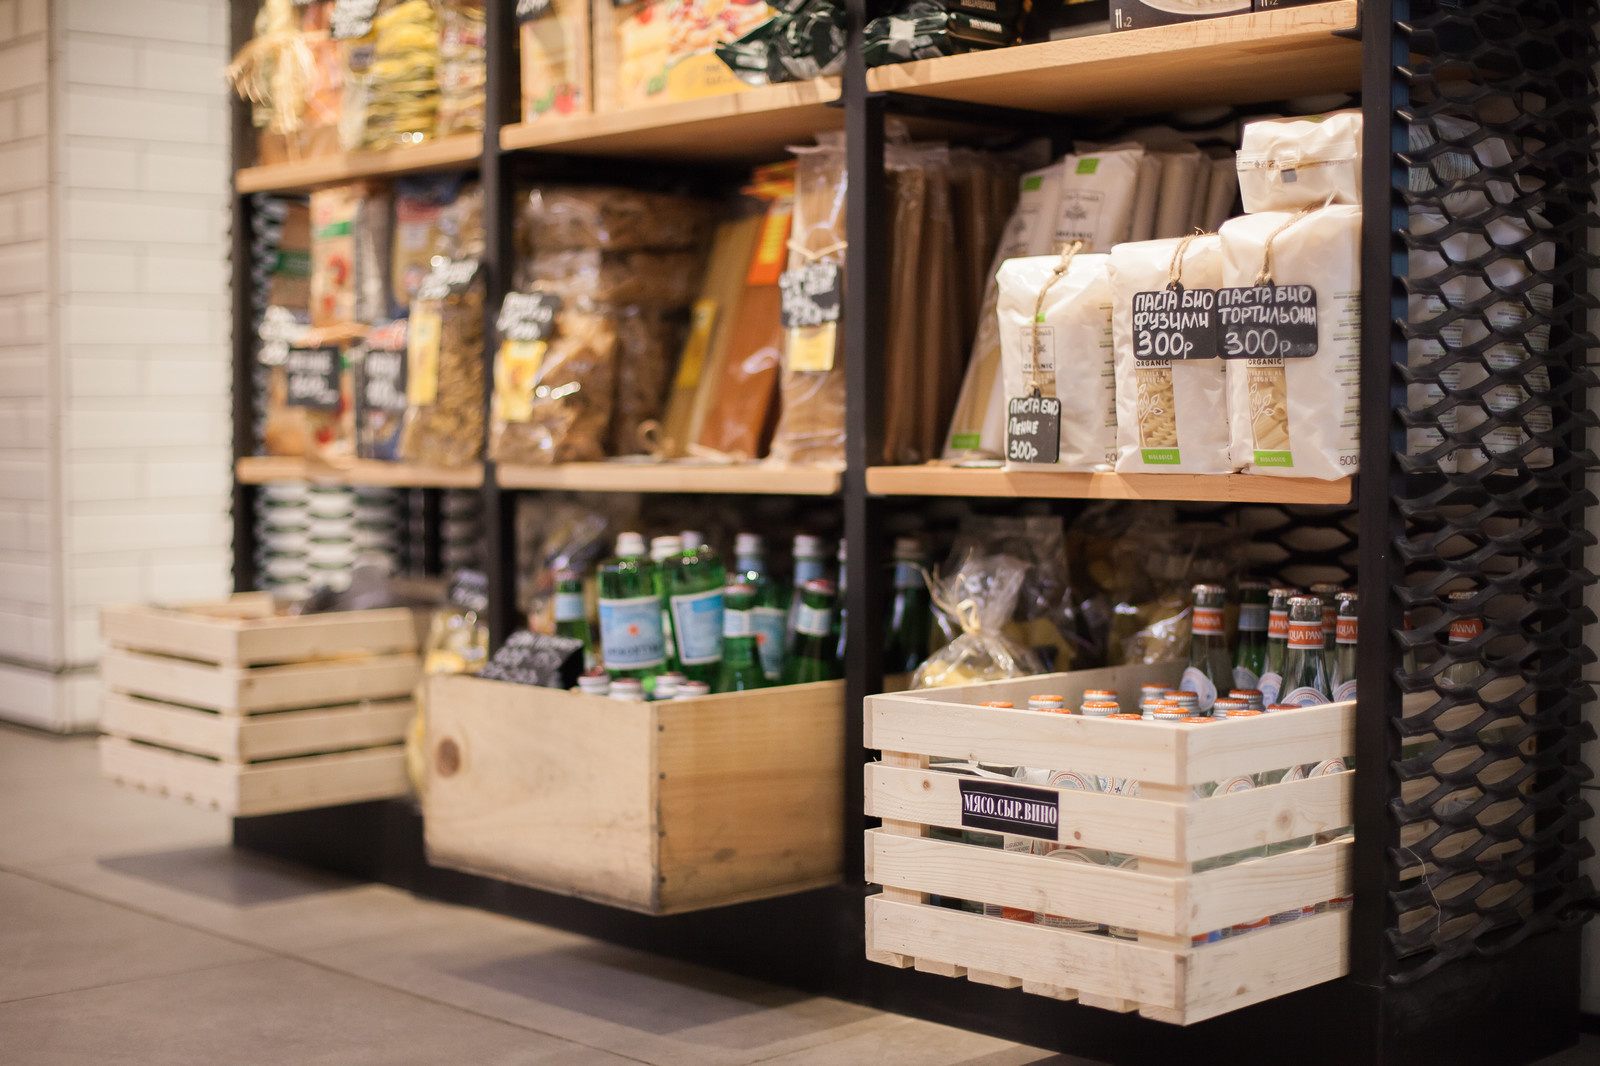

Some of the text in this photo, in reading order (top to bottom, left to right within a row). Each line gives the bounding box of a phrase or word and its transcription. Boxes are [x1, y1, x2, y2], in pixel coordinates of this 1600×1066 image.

[1135, 289, 1214, 311] ПАСТА БИО
[1218, 285, 1312, 306] ПАСТА БИО
[1134, 312, 1209, 332] ФУЗИЛЛИ
[1218, 305, 1317, 327] ТОРТИЛЬОНИ
[1137, 330, 1193, 359] 300р
[1224, 328, 1292, 359] 300р
[1136, 359, 1169, 367] ORGANIC
[1247, 358, 1282, 366] ORGANIC
[1010, 397, 1059, 416] ПАСТА БИО
[964, 794, 1057, 825] МЯСО.СЫР.ВИНО
